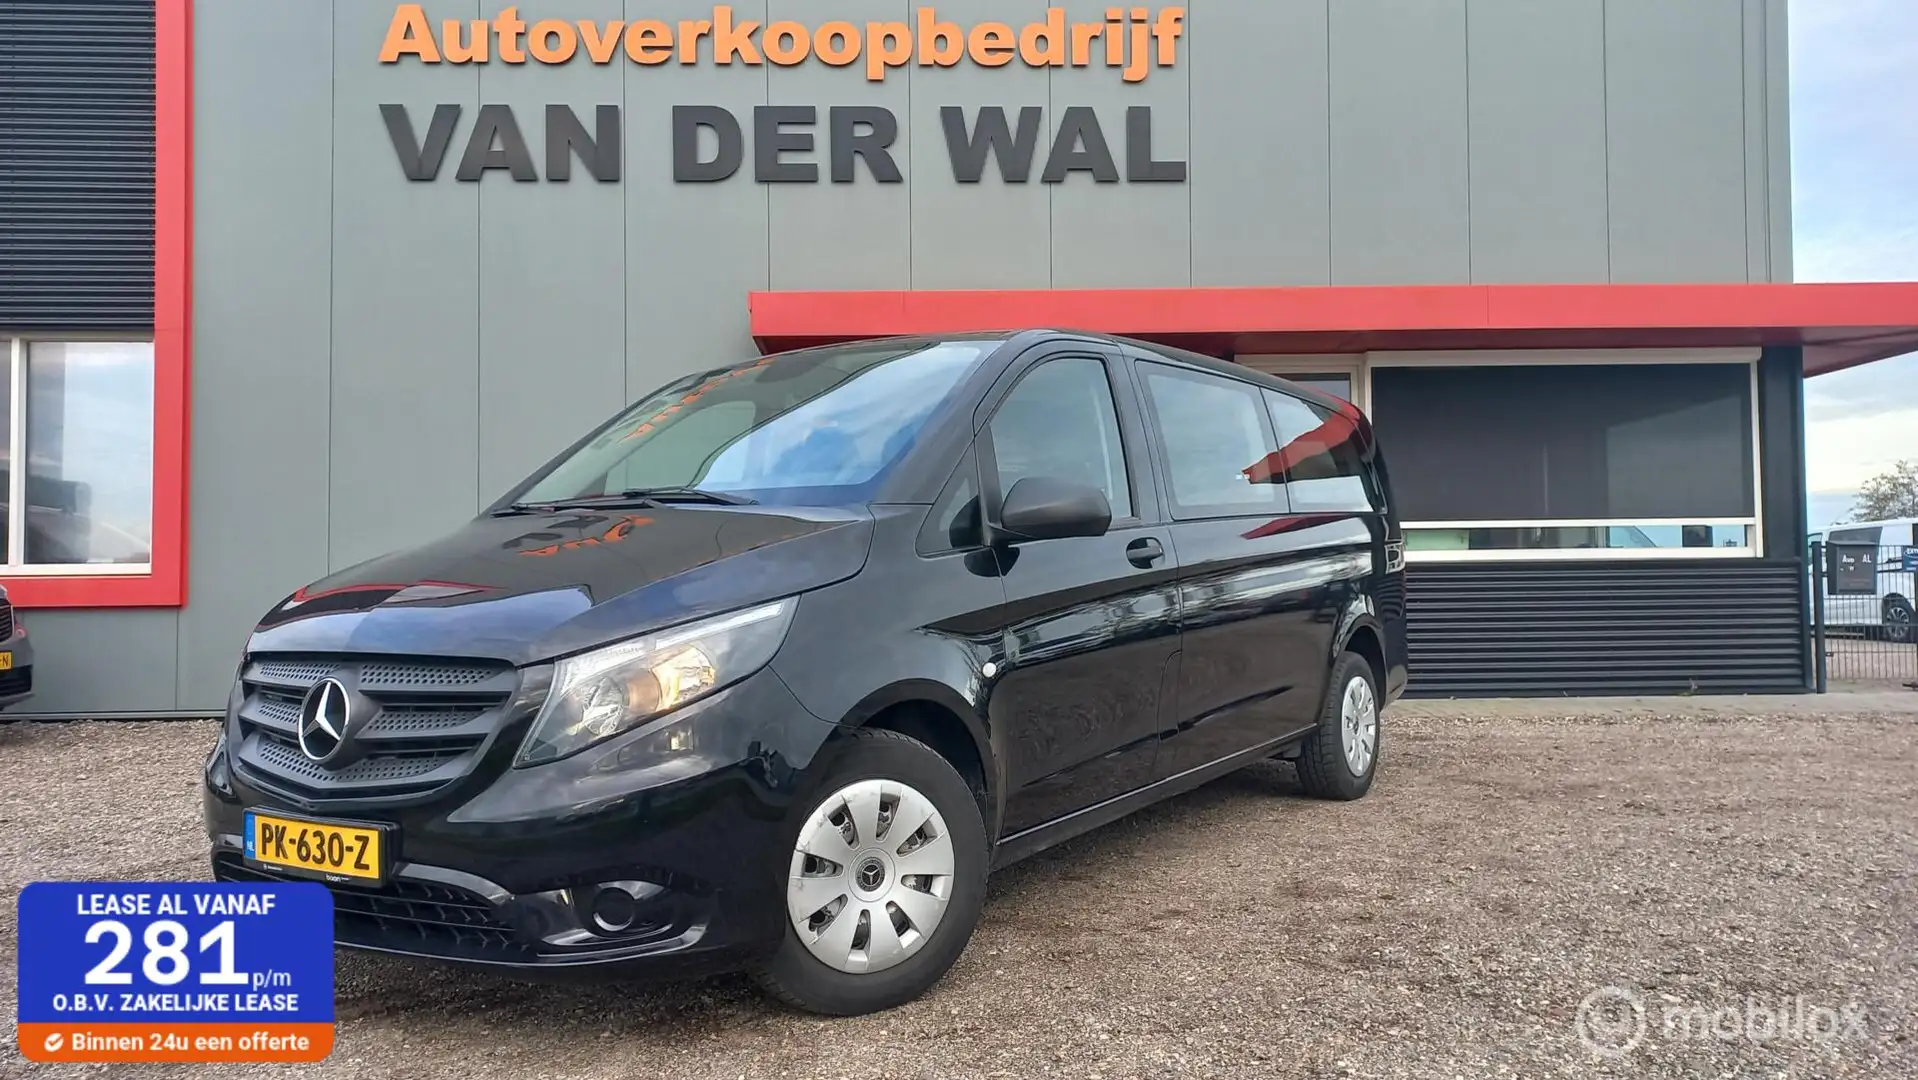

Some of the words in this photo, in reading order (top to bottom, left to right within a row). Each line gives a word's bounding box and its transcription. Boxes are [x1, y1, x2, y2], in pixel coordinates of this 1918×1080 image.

[379, 4, 1185, 82] Autoverkoopbedrijf
[379, 104, 620, 182] VAN
[672, 106, 903, 183] DER
[940, 106, 1187, 184] WAL
[261, 822, 370, 871] PK-630-Z
